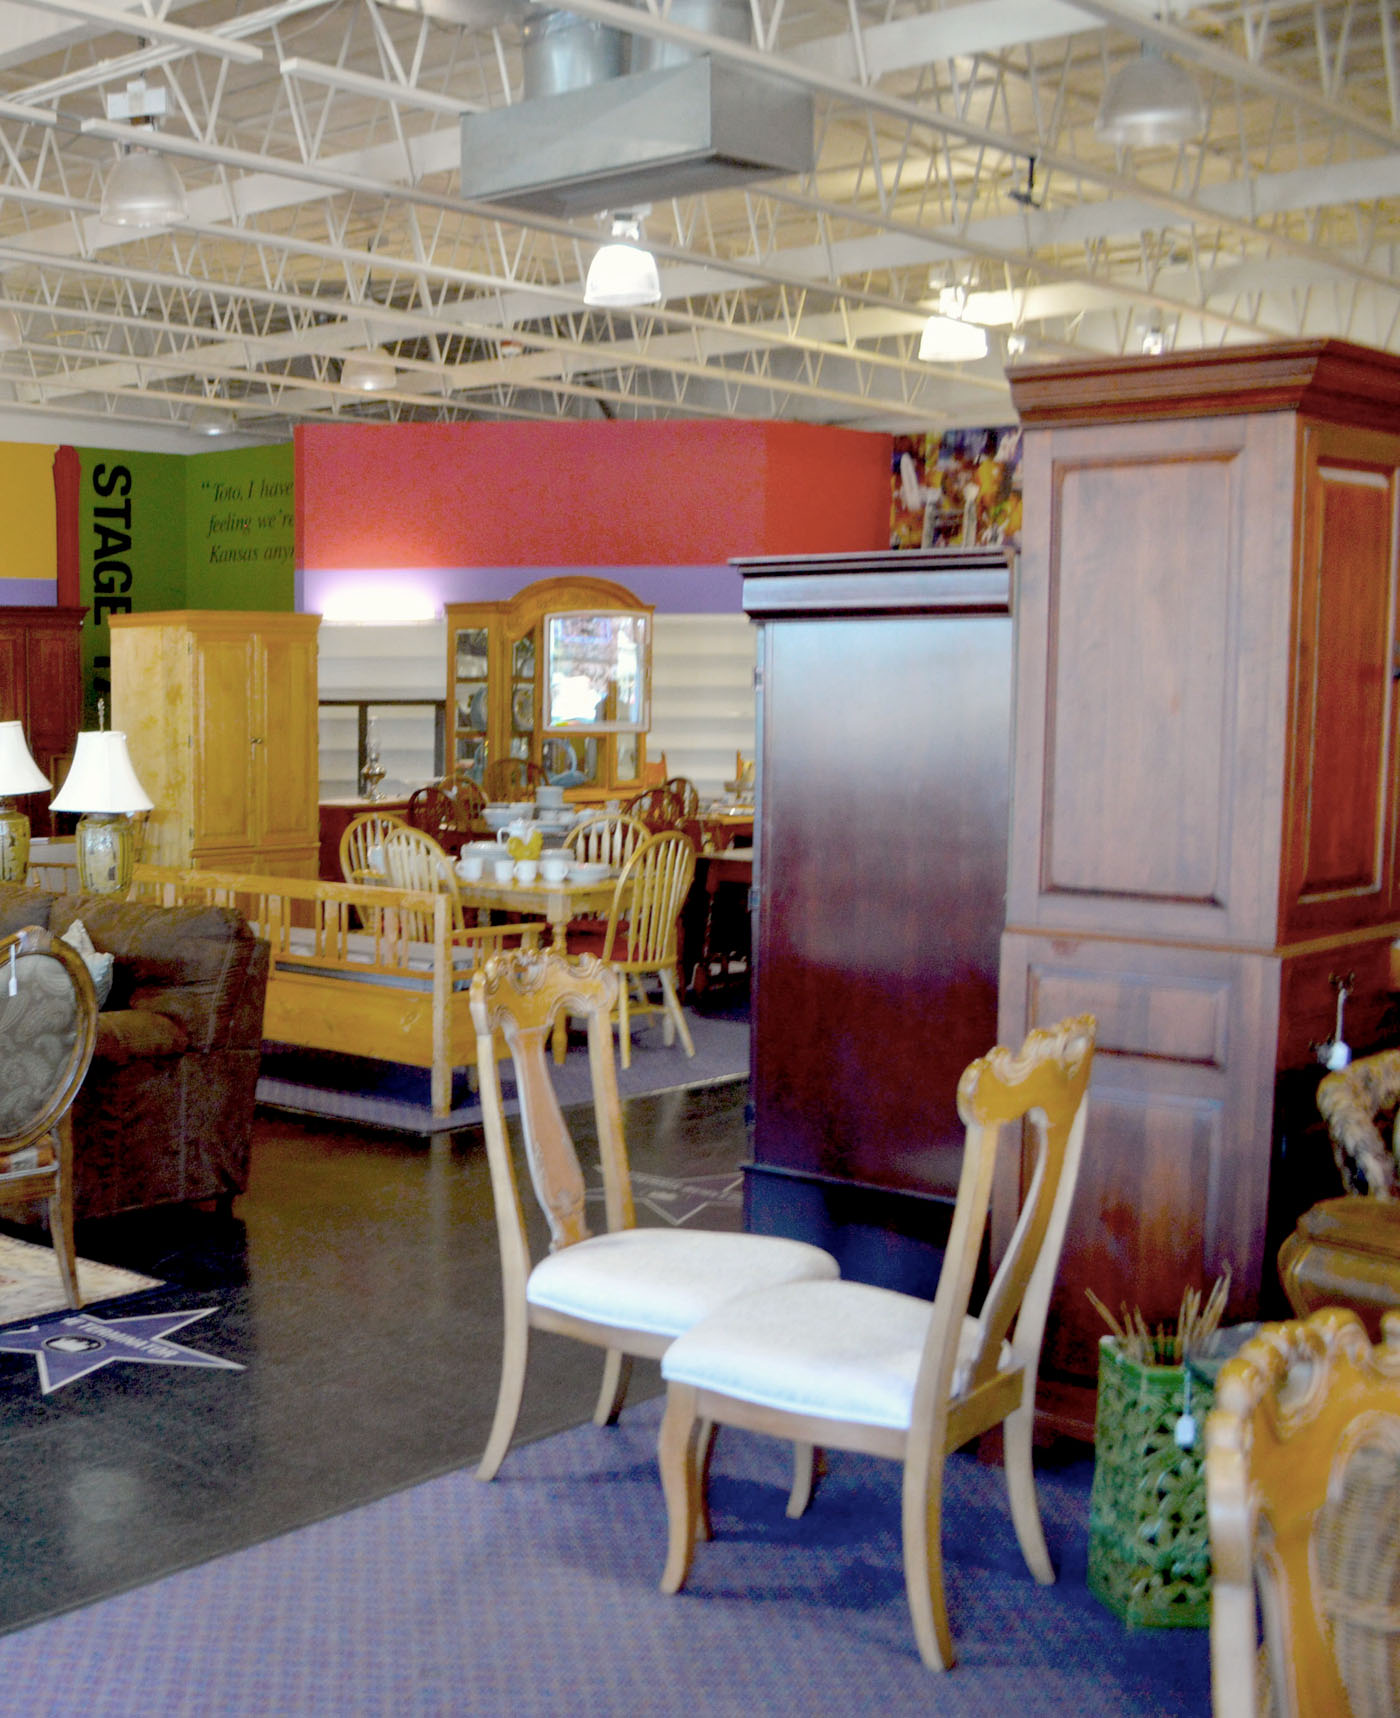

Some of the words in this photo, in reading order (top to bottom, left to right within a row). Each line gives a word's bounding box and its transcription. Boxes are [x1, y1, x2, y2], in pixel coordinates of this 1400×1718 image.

[247, 480, 255, 499] I
[260, 478, 295, 498] have
[206, 512, 252, 538] feeling
[92, 463, 132, 626] STAGE
[209, 544, 258, 563] Kansas
